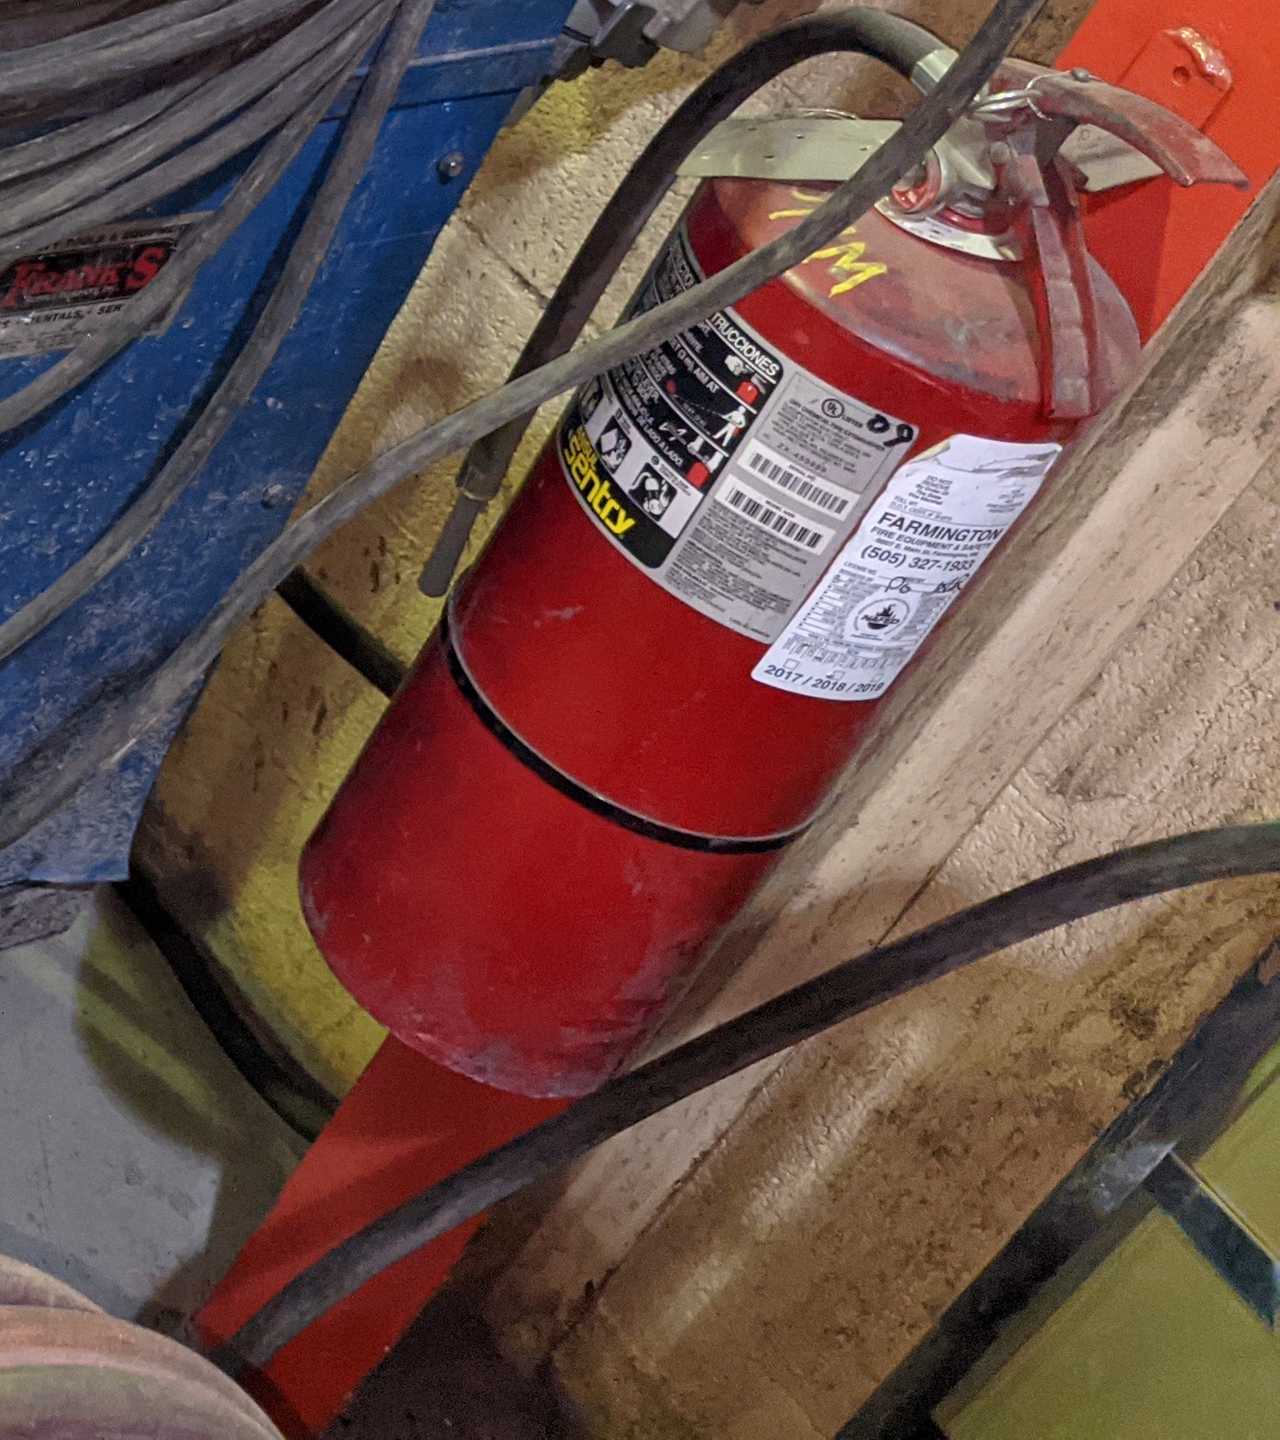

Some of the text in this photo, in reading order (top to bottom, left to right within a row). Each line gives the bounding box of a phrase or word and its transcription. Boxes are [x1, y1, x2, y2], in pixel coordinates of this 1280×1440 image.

[706, 310, 780, 377] TRUCCIONES
[870, 526, 895, 539] FIRE
[895, 532, 953, 552] EQUIPMENT
[877, 512, 1004, 540] FARMINGTON
[860, 543, 975, 571] (505) 327-1933
[764, 664, 804, 682] 2017
[811, 677, 846, 692] 2018
